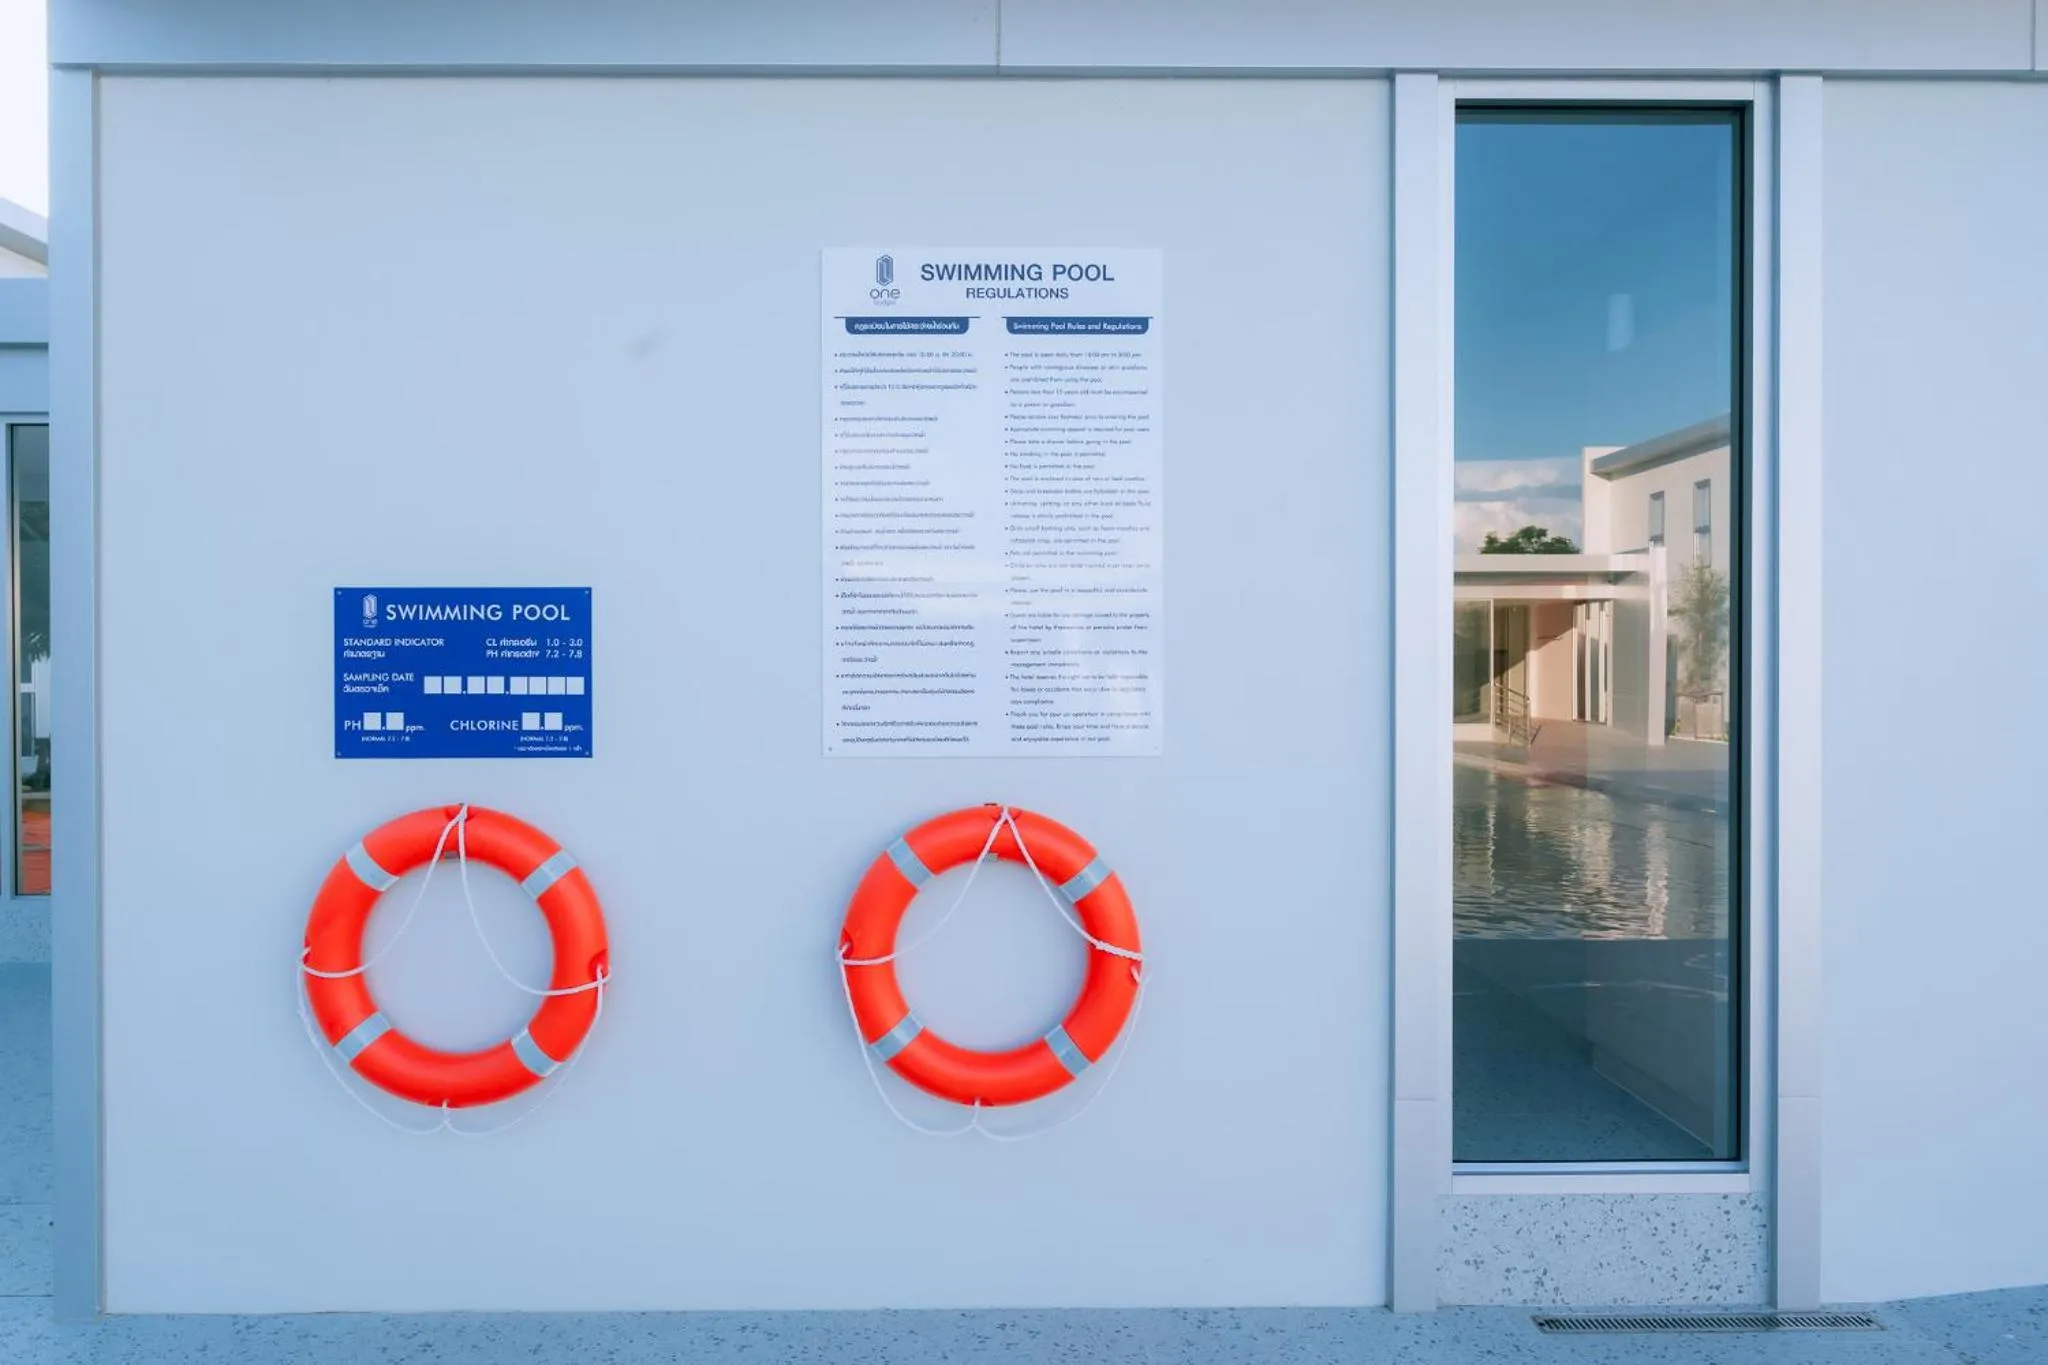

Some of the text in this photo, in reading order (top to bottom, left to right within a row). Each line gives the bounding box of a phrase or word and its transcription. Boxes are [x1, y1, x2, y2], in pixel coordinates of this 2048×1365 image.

[920, 263, 1115, 282] SWIMMING POOL
[869, 288, 901, 300] one
[966, 287, 1069, 300] REGULATIONS
[1013, 321, 1143, 332] Swimming Pool Rules and Regulations
[385, 603, 571, 621] SWIMMING POOL
[343, 638, 445, 647] STANDARD INDICATOR
[485, 638, 498, 647] CL
[546, 638, 560, 647] 1.0
[568, 638, 583, 647] 3.0
[485, 649, 499, 659] PH
[545, 649, 560, 659] 7.2
[568, 649, 583, 659] 7.8
[343, 672, 415, 682] SAMPLING DATE
[344, 720, 362, 731] PH
[449, 719, 520, 731] CHLORINE
